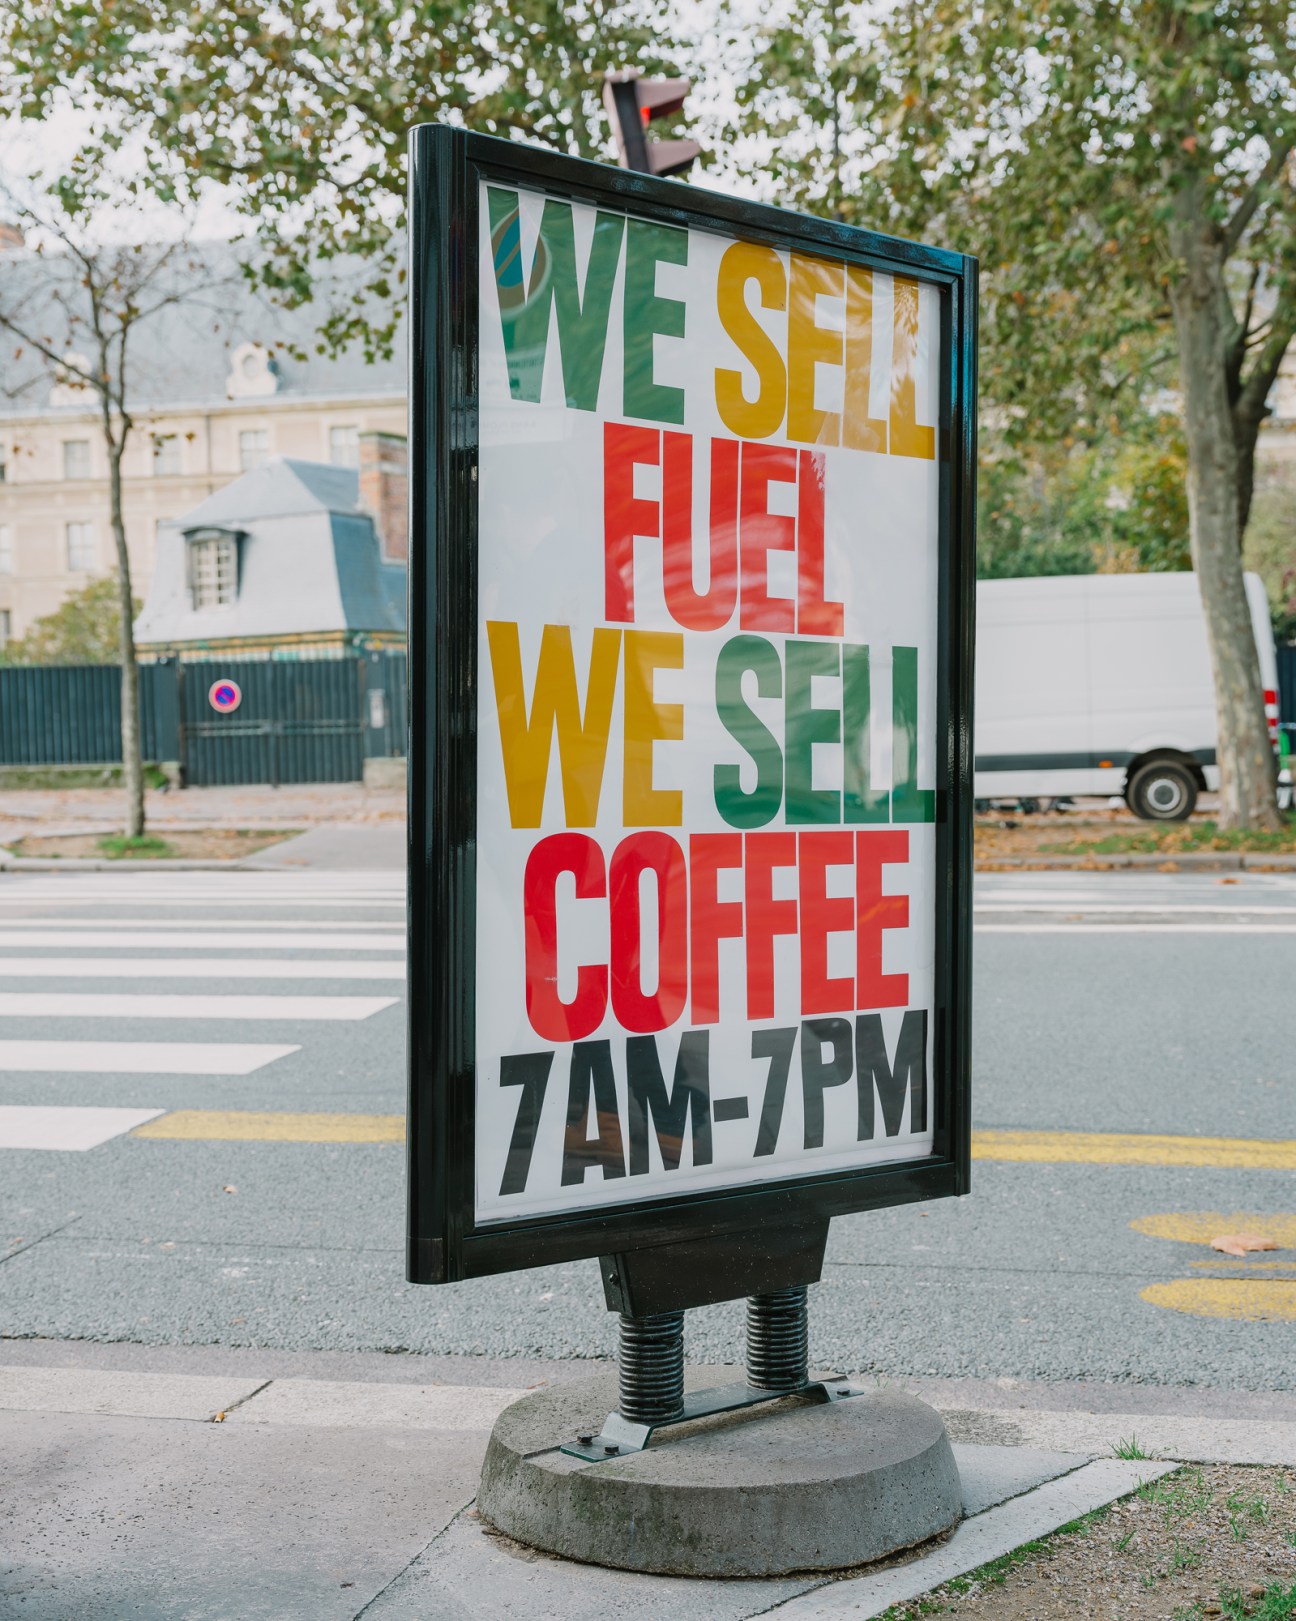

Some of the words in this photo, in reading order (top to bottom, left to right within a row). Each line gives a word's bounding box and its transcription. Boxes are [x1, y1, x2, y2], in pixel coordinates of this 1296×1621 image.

[486, 185, 689, 425] WE
[714, 240, 936, 460] SELL
[604, 421, 844, 637] FUEL
[486, 620, 684, 829] WE
[713, 634, 936, 830] SELL
[523, 829, 910, 1042] COFFEE
[498, 1009, 928, 1196] 7AM-7PM
